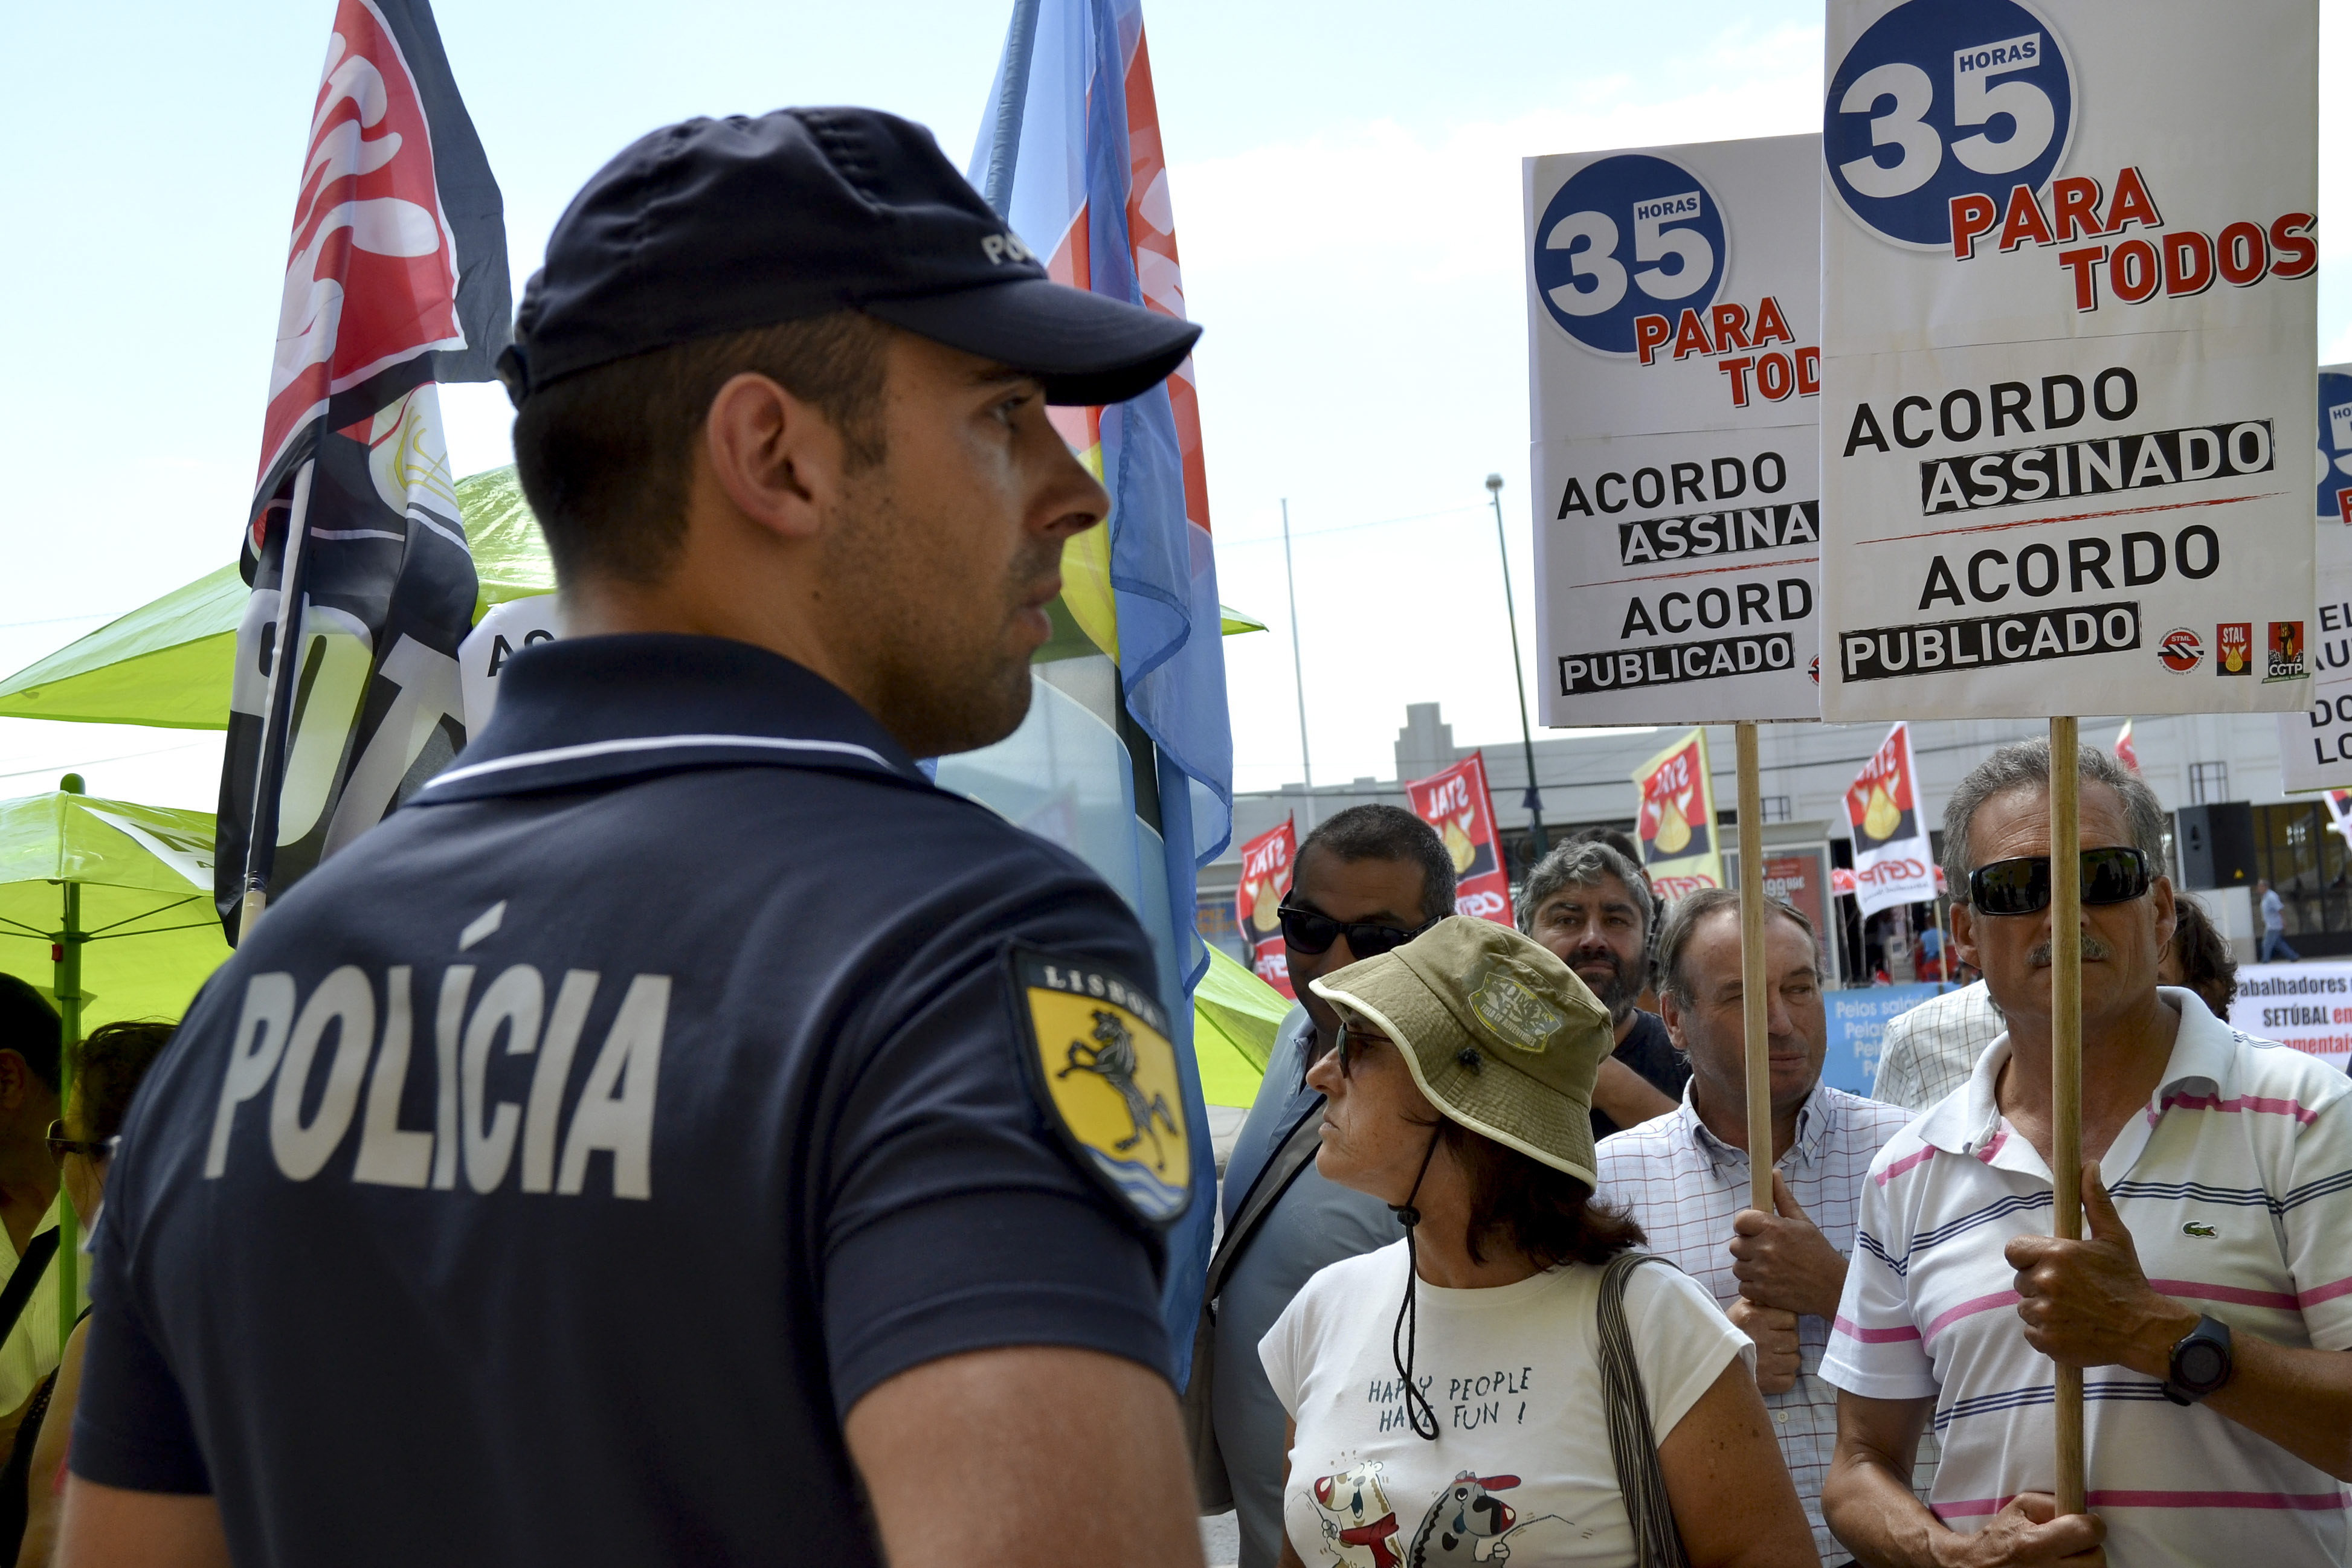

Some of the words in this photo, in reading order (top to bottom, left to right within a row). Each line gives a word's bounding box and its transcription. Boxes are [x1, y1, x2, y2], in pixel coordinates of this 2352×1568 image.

[1959, 40, 2038, 72] HORAS
[1839, 33, 2055, 198] 35
[1638, 197, 1698, 220] HORAS
[1949, 166, 2164, 261] PARA
[1546, 191, 1713, 316] 35
[2059, 213, 2318, 313] TODOS
[1634, 296, 1796, 366] PARA
[1843, 367, 2138, 458] ACORDO
[1557, 452, 1787, 520] ACORDO
[1926, 422, 2271, 513] ASSINADO
[1624, 505, 1818, 565] ASSINA
[1918, 524, 2220, 610] ACORDO
[1620, 578, 1820, 639] ACORD
[2223, 627, 2245, 643] STAL
[1564, 637, 1791, 690] PUBLICADO
[1846, 608, 2135, 676] PUBLICADO
[2269, 663, 2302, 676] CGTP
[1480, 1003, 1496, 1020] FIELD
[1494, 1013, 1504, 1022] OF
[1501, 1020, 1537, 1047] ADVENTURES
[1836, 1000, 1877, 1018] Pelos
[2263, 1003, 2330, 1027] SETÚBAL
[204, 900, 672, 1200] POLÍCIA
[1854, 1039, 1882, 1058] Pel
[1368, 1375, 1432, 1403] HAPY
[1449, 1367, 1532, 1401] PEOPLE
[1454, 1401, 1499, 1430] FUN
